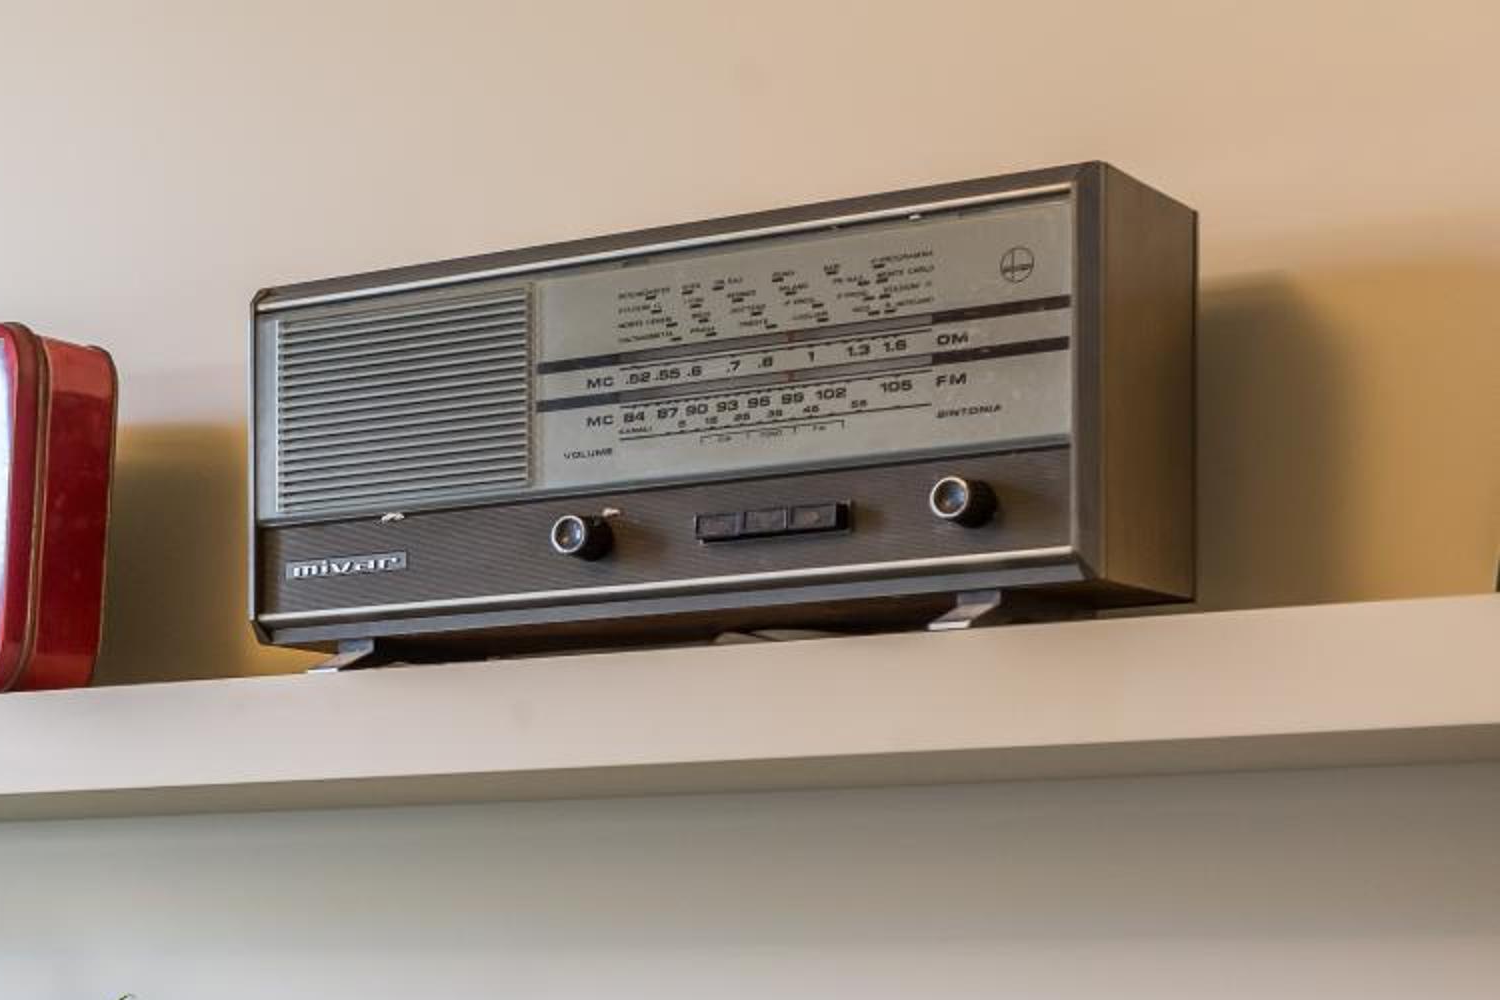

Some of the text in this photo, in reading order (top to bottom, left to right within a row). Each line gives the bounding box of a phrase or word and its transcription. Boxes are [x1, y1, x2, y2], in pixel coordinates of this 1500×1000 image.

[586, 376, 615, 389] MC
[654, 368, 681, 381] .55
[687, 365, 703, 378] .6
[726, 360, 741, 373] .7
[807, 351, 816, 363] 1
[849, 343, 871, 358] 1.3
[936, 331, 969, 346] OM
[586, 414, 614, 428] MC
[623, 411, 645, 424] 84
[657, 407, 679, 420] 87
[685, 403, 708, 417] 90
[716, 400, 738, 413] 93
[747, 396, 771, 409] 96
[815, 387, 847, 401] 102
[879, 380, 913, 393] 105
[936, 372, 967, 387] FM
[937, 403, 1002, 418] SINTONIA
[564, 447, 613, 460] VOLUME
